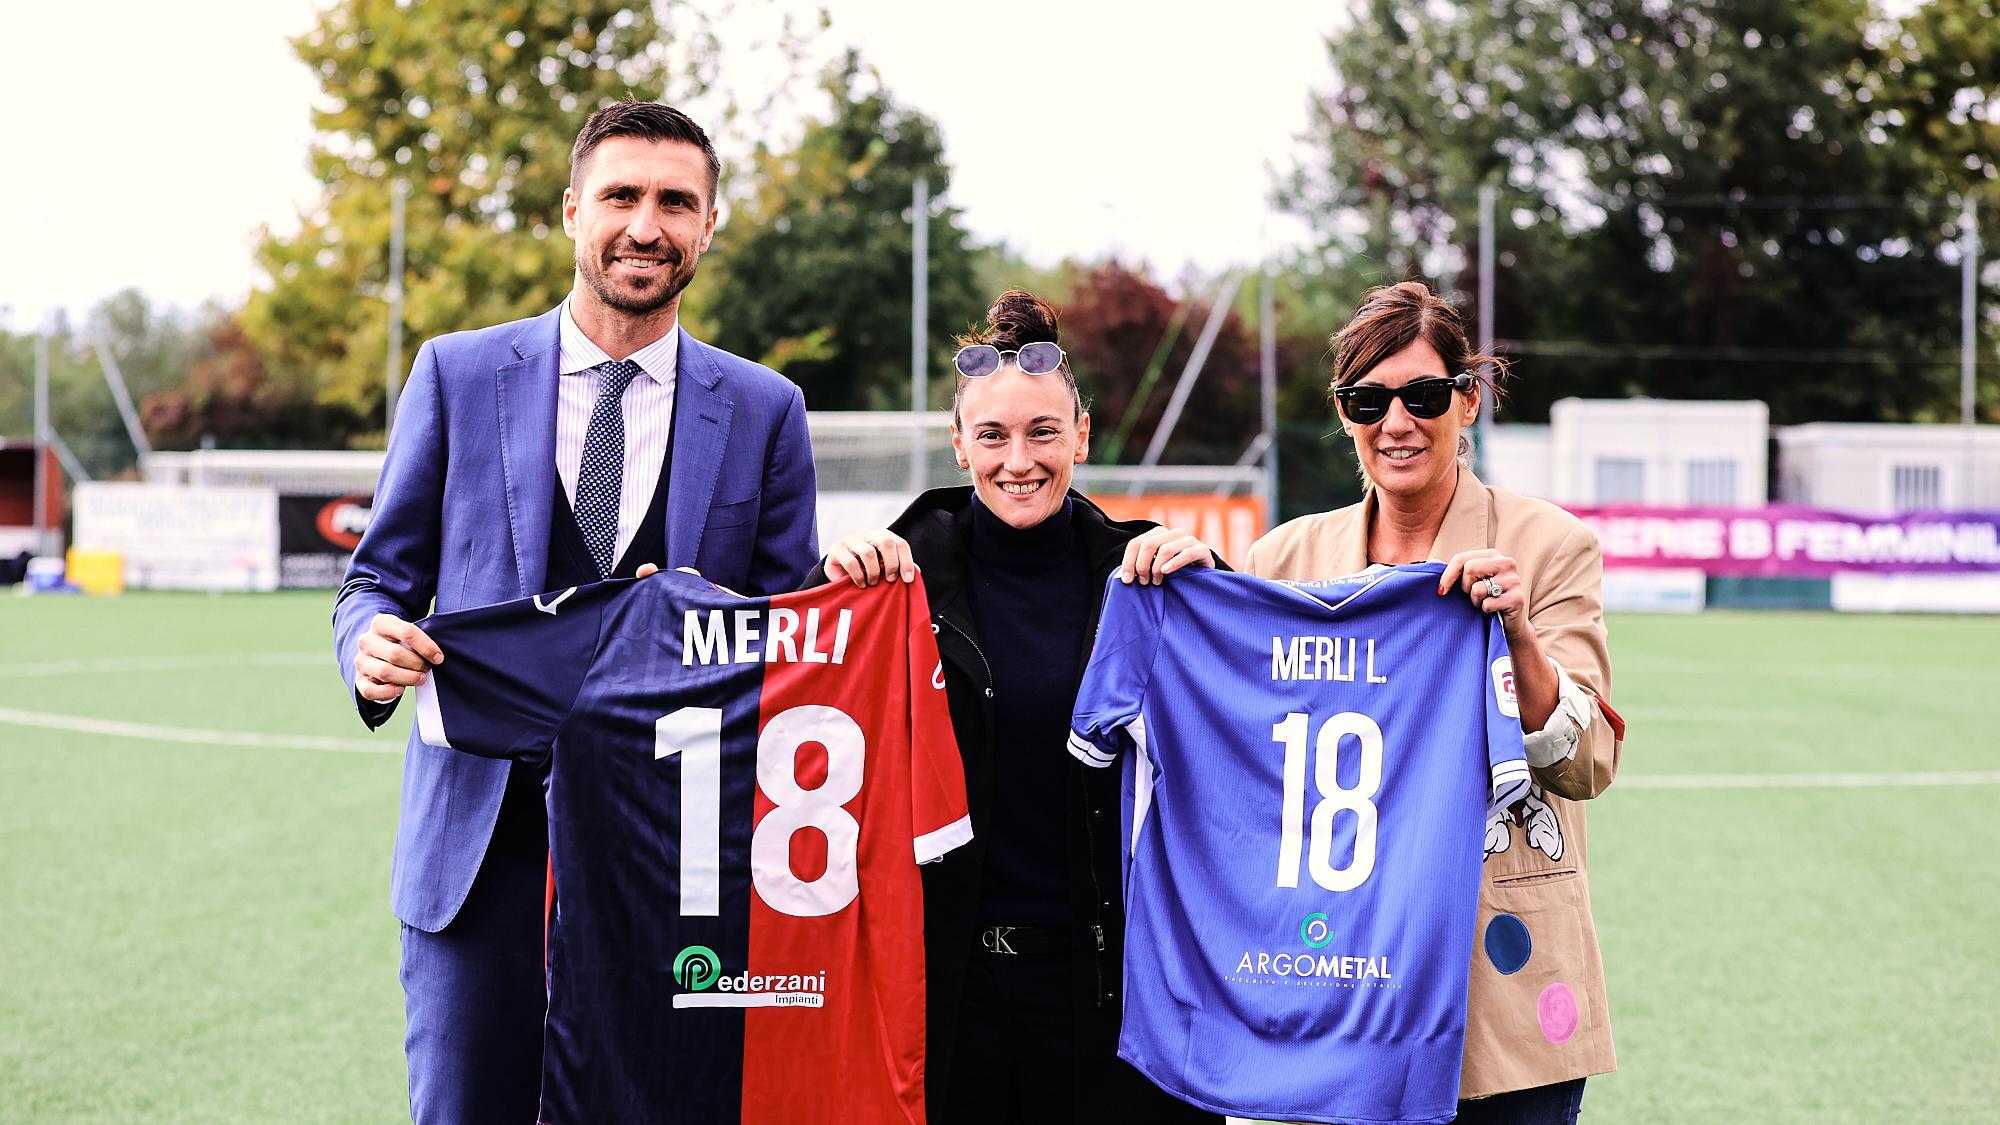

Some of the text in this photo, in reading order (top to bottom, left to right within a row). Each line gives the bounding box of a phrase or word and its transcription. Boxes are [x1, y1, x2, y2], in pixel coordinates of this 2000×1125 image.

[1729, 518, 1773, 560] B
[682, 607, 852, 665] MERLI
[1271, 636, 1388, 684] MERLI L.
[654, 705, 866, 916] 18
[1272, 711, 1384, 892] 18
[673, 945, 826, 992] Pederzani
[1236, 951, 1392, 980] ARGOMETAL
[775, 993, 819, 1006] Impianti
